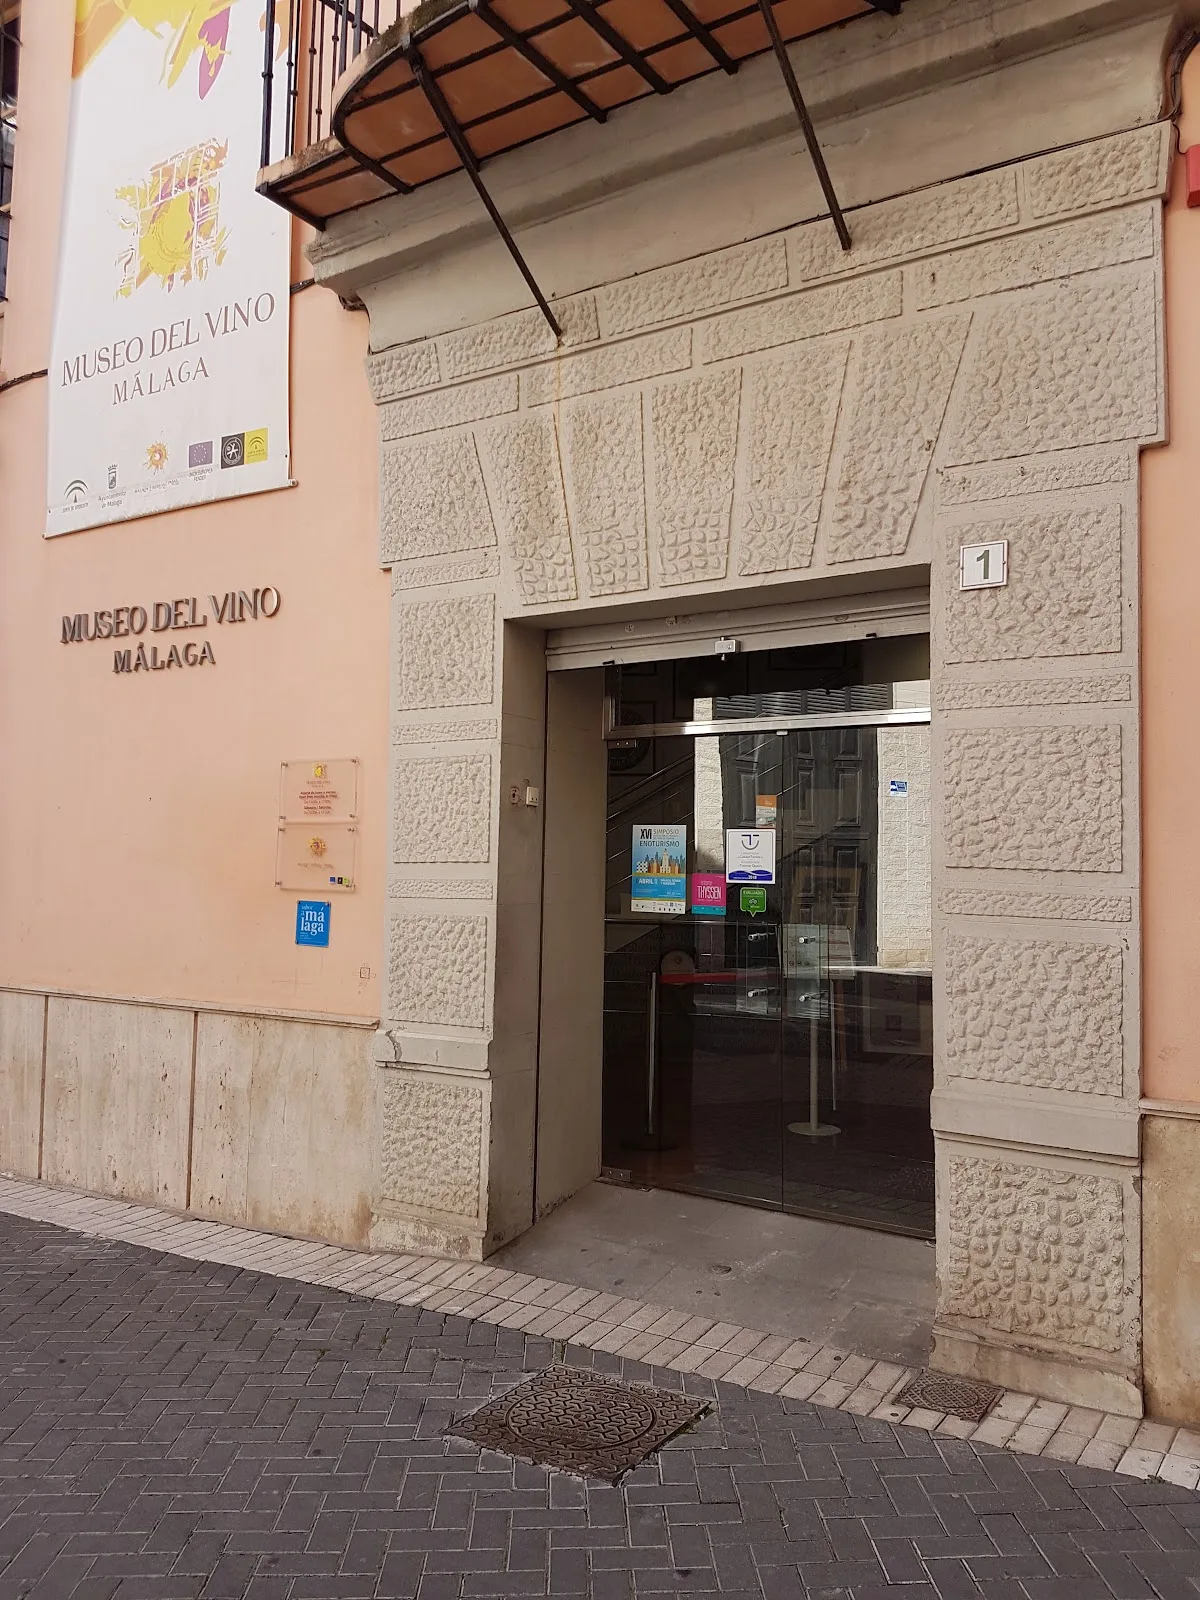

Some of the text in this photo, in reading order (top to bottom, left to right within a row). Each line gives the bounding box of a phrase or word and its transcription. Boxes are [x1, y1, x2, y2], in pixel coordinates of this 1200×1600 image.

[61, 292, 276, 387] MUSEO DEL VINO
[112, 356, 210, 406] MÁLAGA
[976, 549, 990, 580] 1
[60, 586, 282, 644] MUSEO DEL VINO
[112, 641, 216, 674] MÁLAGA
[639, 840, 680, 848] ENOTURISMO
[640, 828, 653, 840] XVI
[697, 885, 722, 900] THYSSEN
[300, 917, 325, 936] laga
